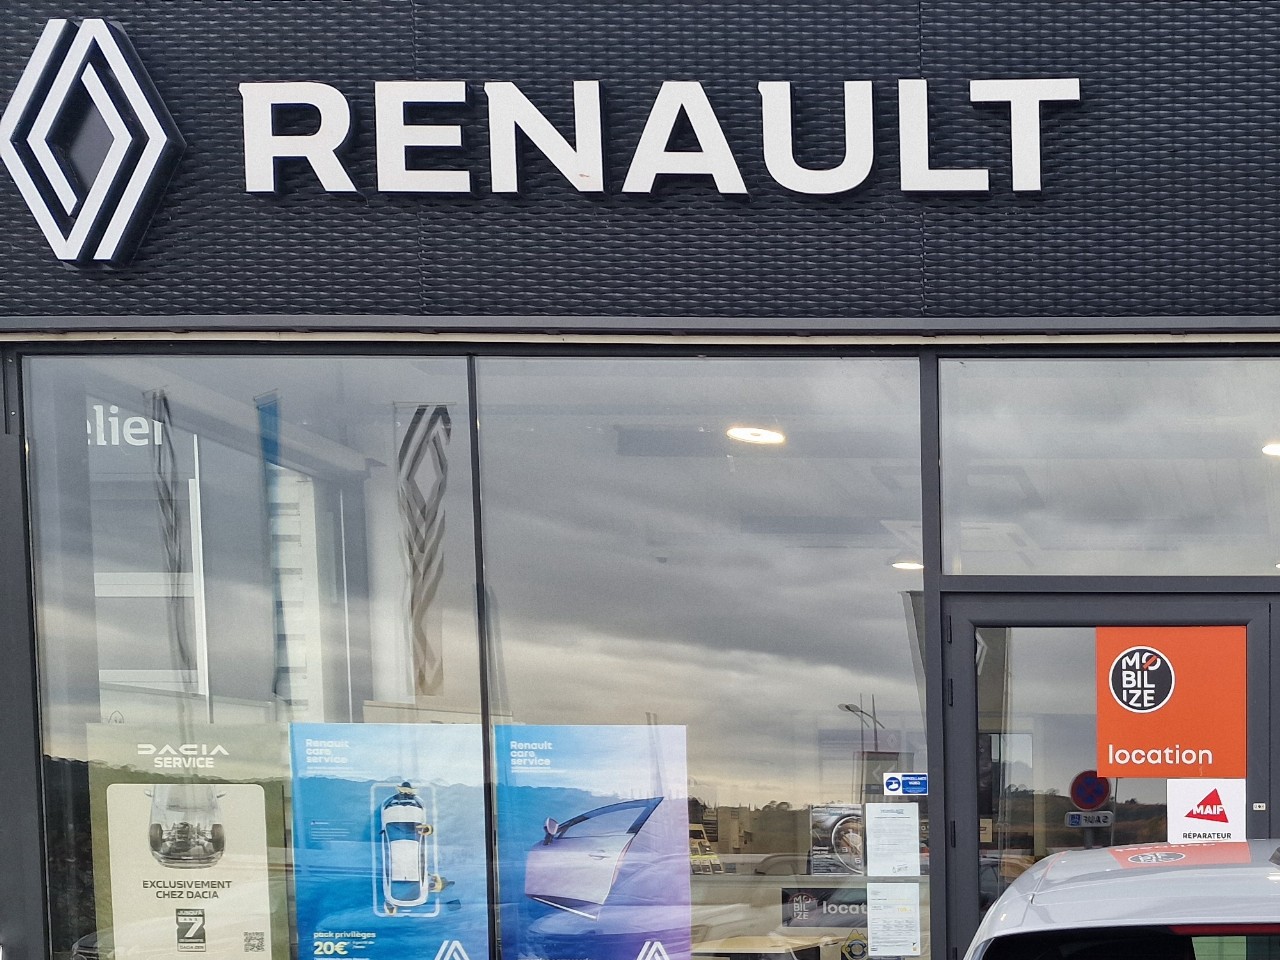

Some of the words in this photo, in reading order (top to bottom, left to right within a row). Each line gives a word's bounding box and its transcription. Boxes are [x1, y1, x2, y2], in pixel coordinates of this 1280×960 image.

[237, 77, 1081, 194] RENAULT
[87, 404, 164, 446] lier
[305, 738, 349, 748] Renault
[510, 740, 553, 750] Renault
[137, 743, 230, 755] DACIA
[510, 750, 535, 758] care
[306, 755, 348, 763] service
[1108, 744, 1213, 765] location
[154, 757, 215, 768] SERVICE
[511, 757, 551, 765] service
[1193, 804, 1225, 815] MAIF
[1182, 831, 1232, 839] RÉPARATEUR
[142, 880, 232, 889] EXCLUSIVEMENT
[155, 890, 184, 899] CHEZ
[186, 890, 219, 899] DACIA
[178, 917, 204, 938] 7
[314, 931, 334, 940] pack
[335, 931, 376, 941] privilèges
[313, 941, 349, 955] 20€
